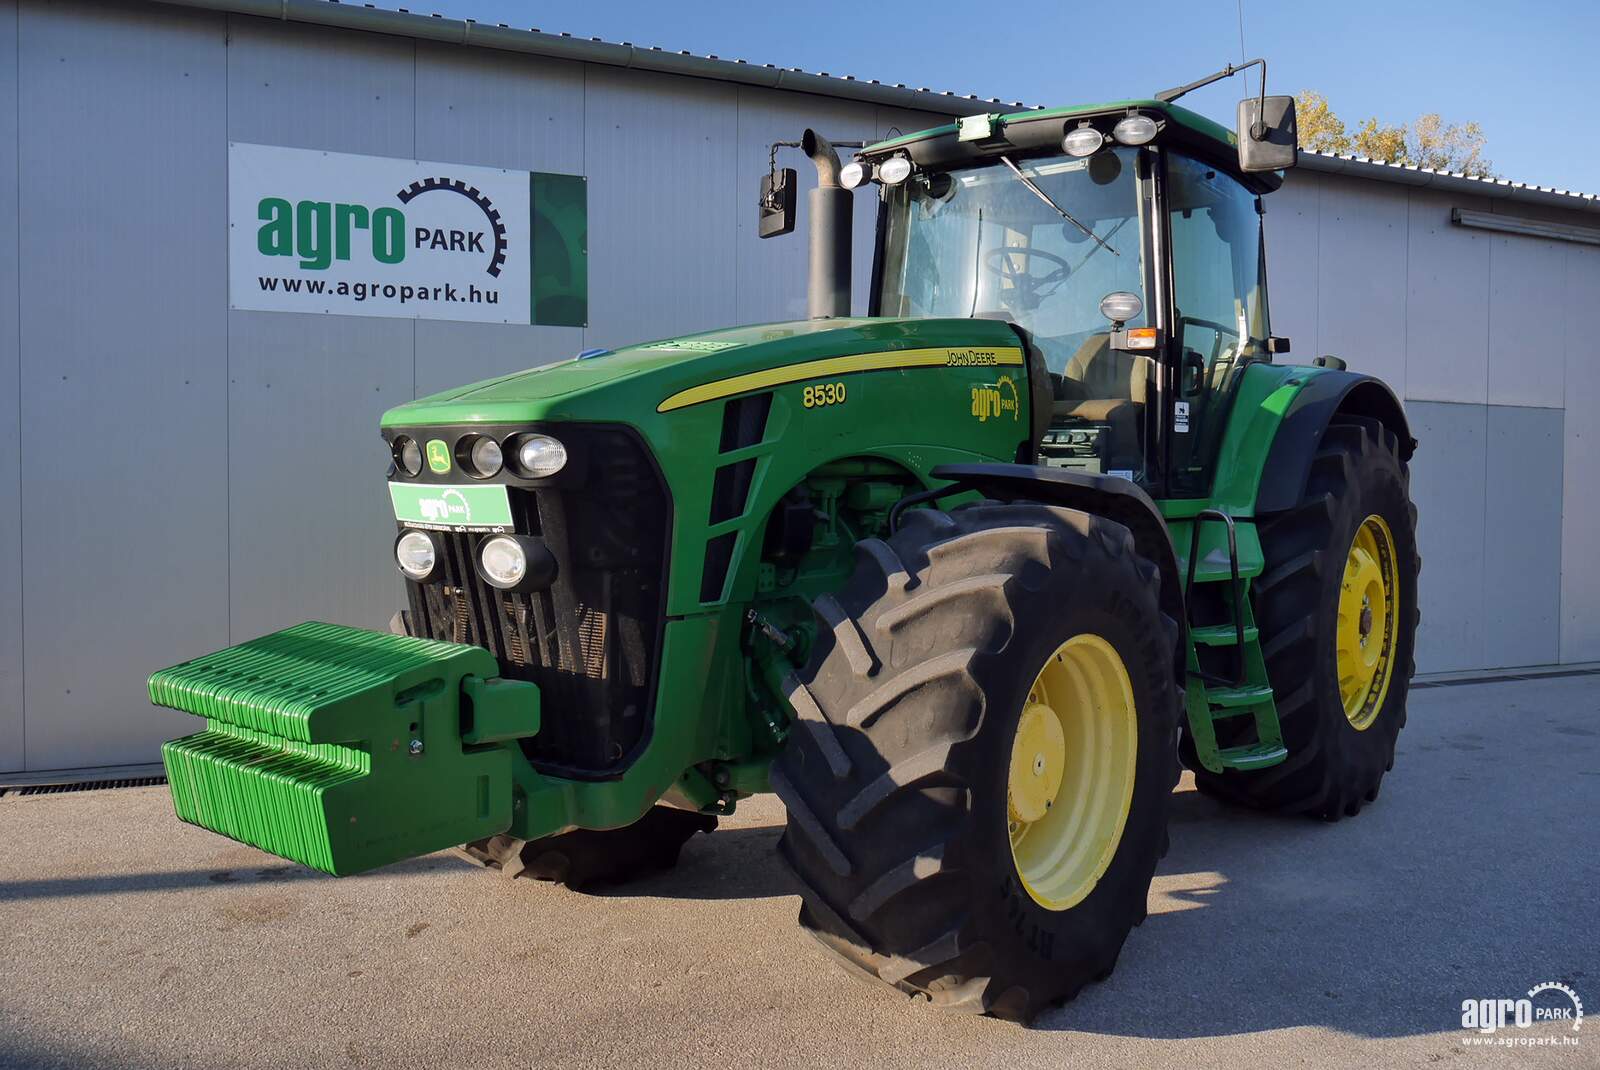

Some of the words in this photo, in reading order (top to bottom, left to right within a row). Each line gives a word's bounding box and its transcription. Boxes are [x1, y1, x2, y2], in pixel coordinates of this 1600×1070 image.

[257, 197, 406, 270] agro
[414, 227, 485, 253] PARK
[258, 276, 499, 304] www.agropark.hu
[803, 382, 846, 408] 8530
[971, 388, 1001, 422] agro
[1001, 399, 1015, 410] PARK
